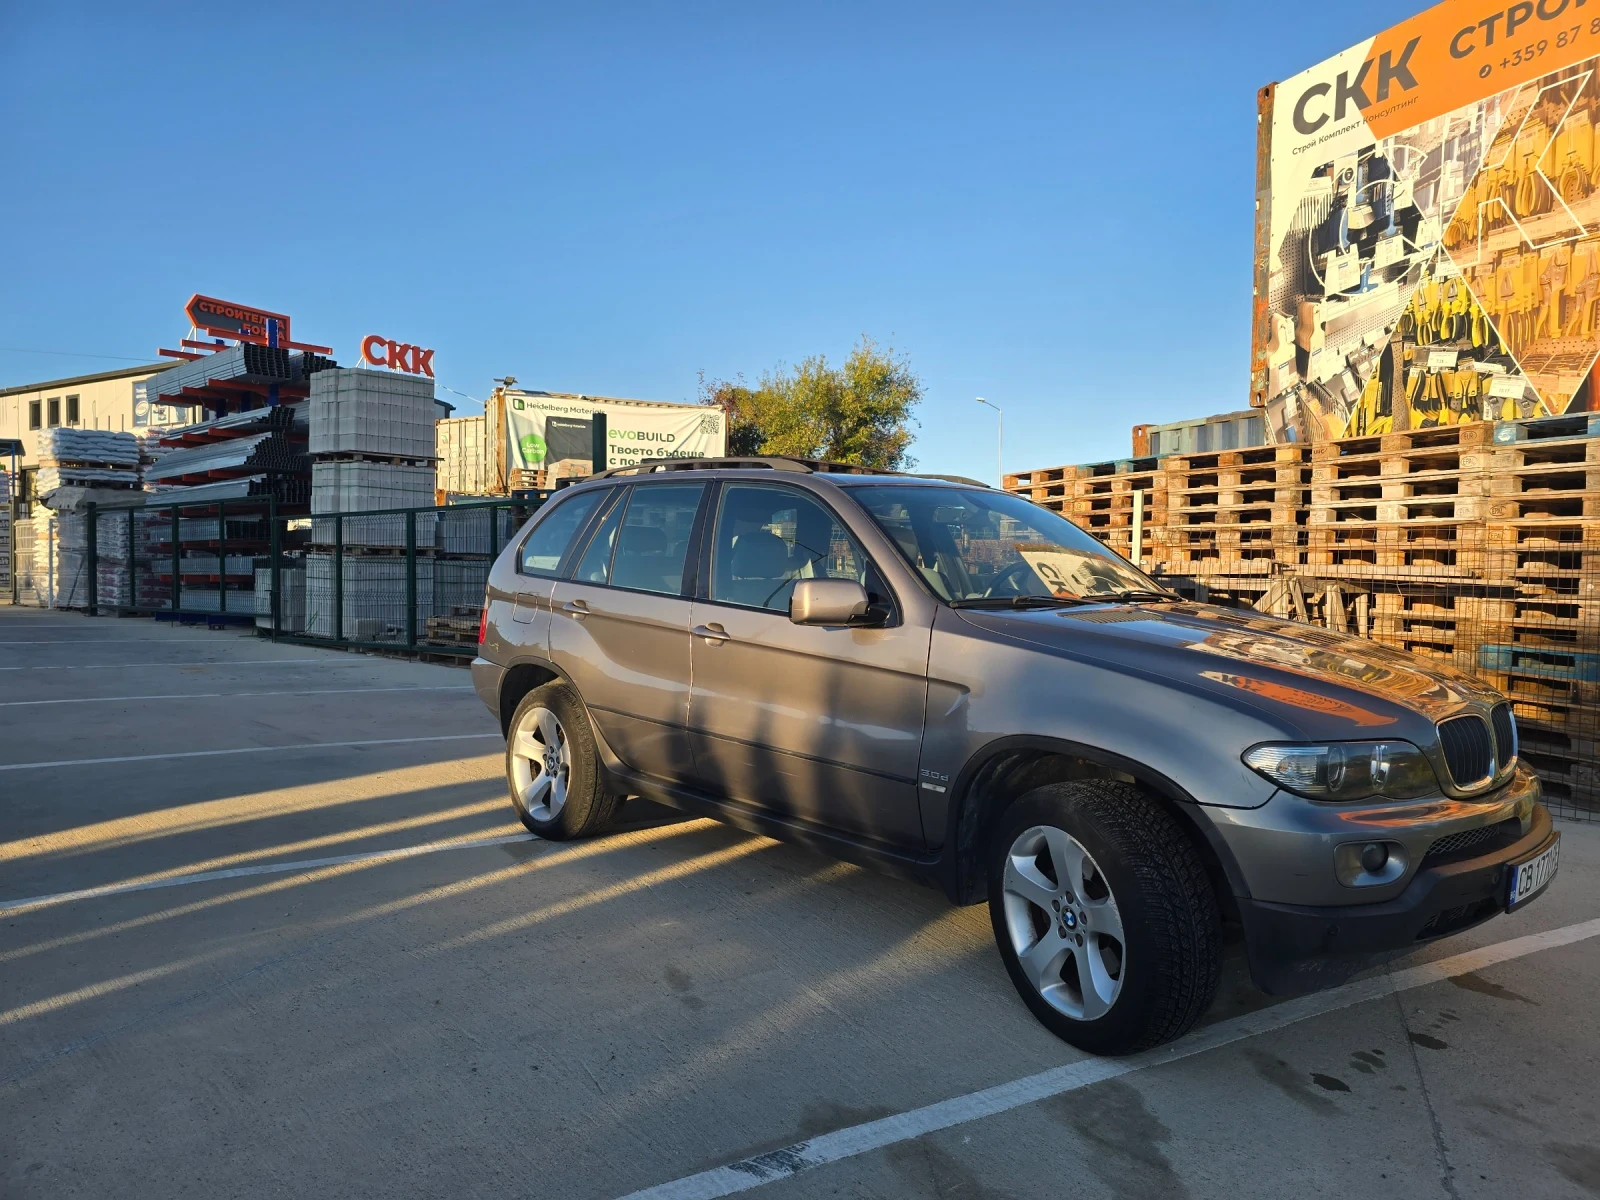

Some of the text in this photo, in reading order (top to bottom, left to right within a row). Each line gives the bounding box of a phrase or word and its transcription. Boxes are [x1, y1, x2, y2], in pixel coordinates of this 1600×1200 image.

[1449, 0, 1588, 59] СТРО
[1499, 39, 1549, 69] +359
[1555, 24, 1582, 49] 87
[1292, 35, 1422, 135] СКК
[1292, 96, 1419, 156] Строй Комплект Консултинг
[198, 301, 285, 329] СТРОИТЕЛА
[361, 334, 435, 378] СКК
[526, 402, 569, 414] Heidelberg
[526, 441, 541, 449] Low
[608, 428, 676, 443] evoBUILD
[521, 447, 545, 455] Carbon
[609, 444, 653, 456] Твоето
